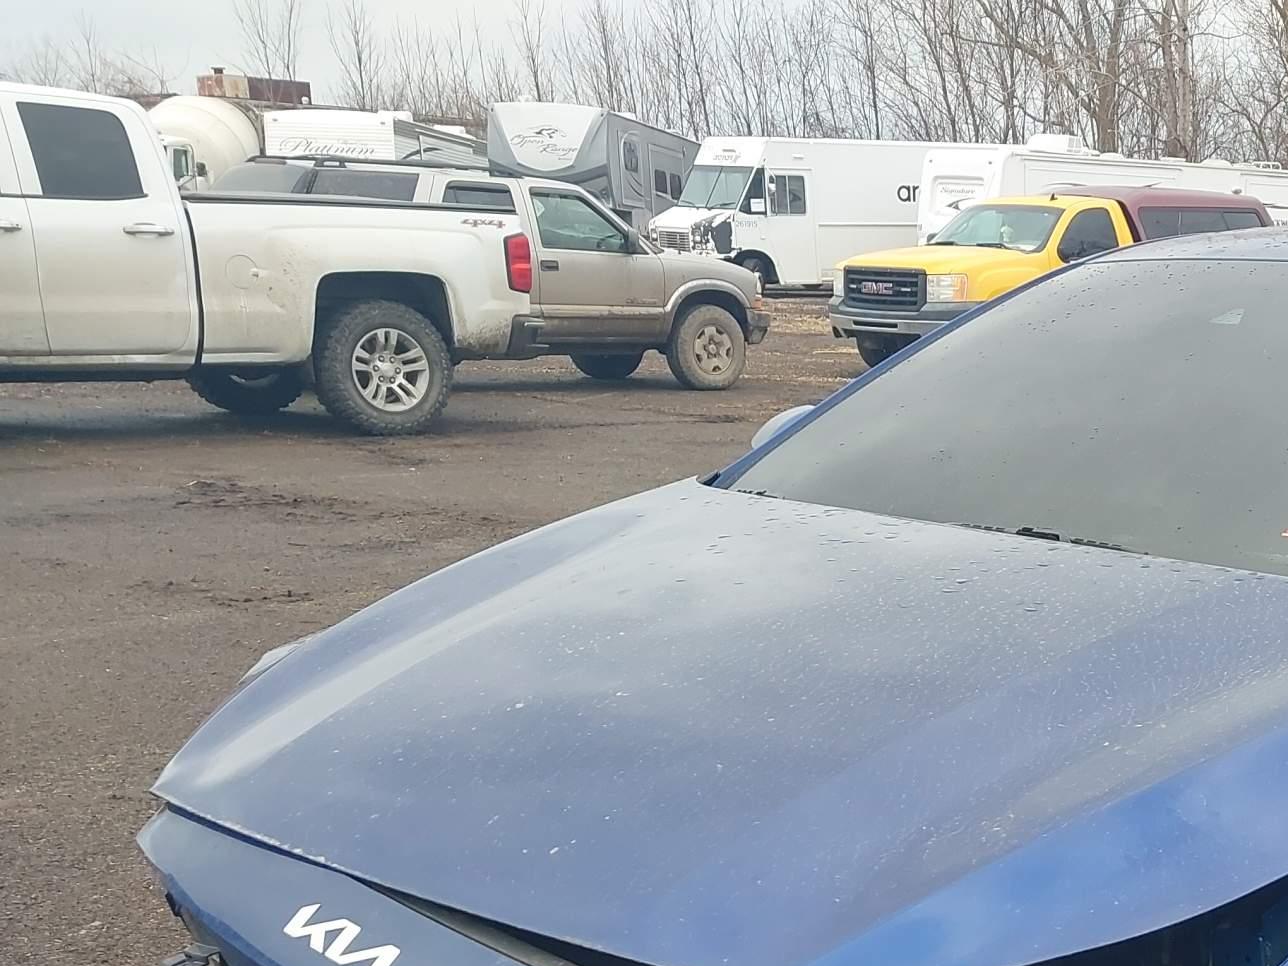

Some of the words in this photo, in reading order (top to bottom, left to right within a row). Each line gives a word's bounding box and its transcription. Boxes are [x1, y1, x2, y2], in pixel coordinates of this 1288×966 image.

[279, 136, 375, 154] Platinum
[897, 184, 921, 202] ar
[861, 281, 893, 295] GMC
